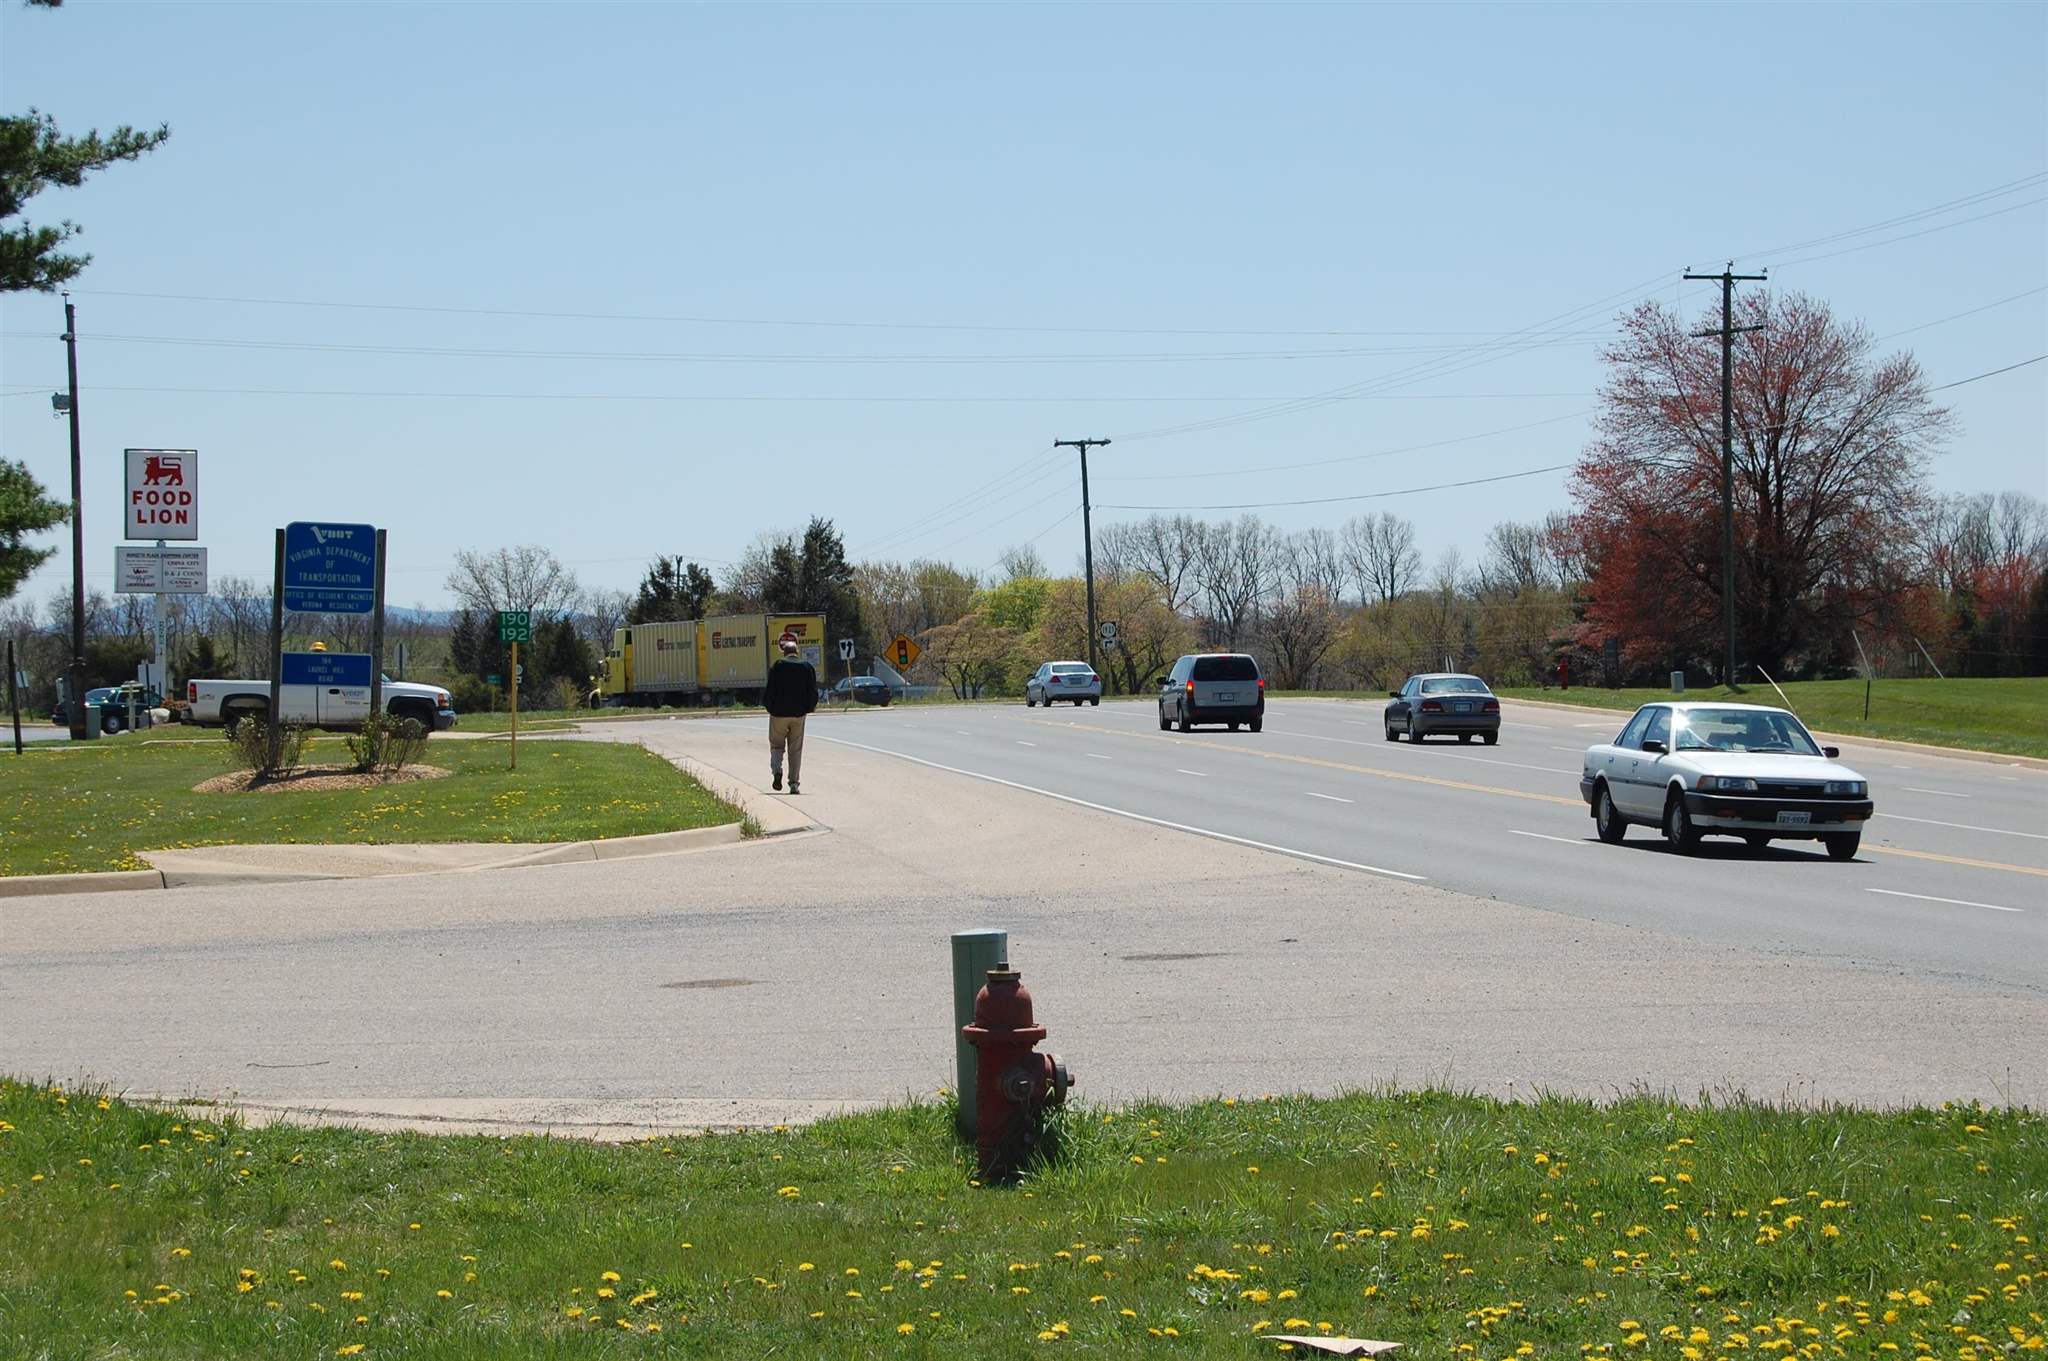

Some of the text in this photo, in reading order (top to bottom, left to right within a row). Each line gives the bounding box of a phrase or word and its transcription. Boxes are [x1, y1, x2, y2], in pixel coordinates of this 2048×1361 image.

[132, 490, 192, 506] FOOD
[136, 509, 188, 524] LION
[289, 546, 371, 566] VIRGINIA DEPARTMENT
[325, 560, 335, 569] OF
[299, 572, 361, 584] TRANSPORTATION
[501, 613, 528, 625] 190
[501, 628, 528, 640] 192
